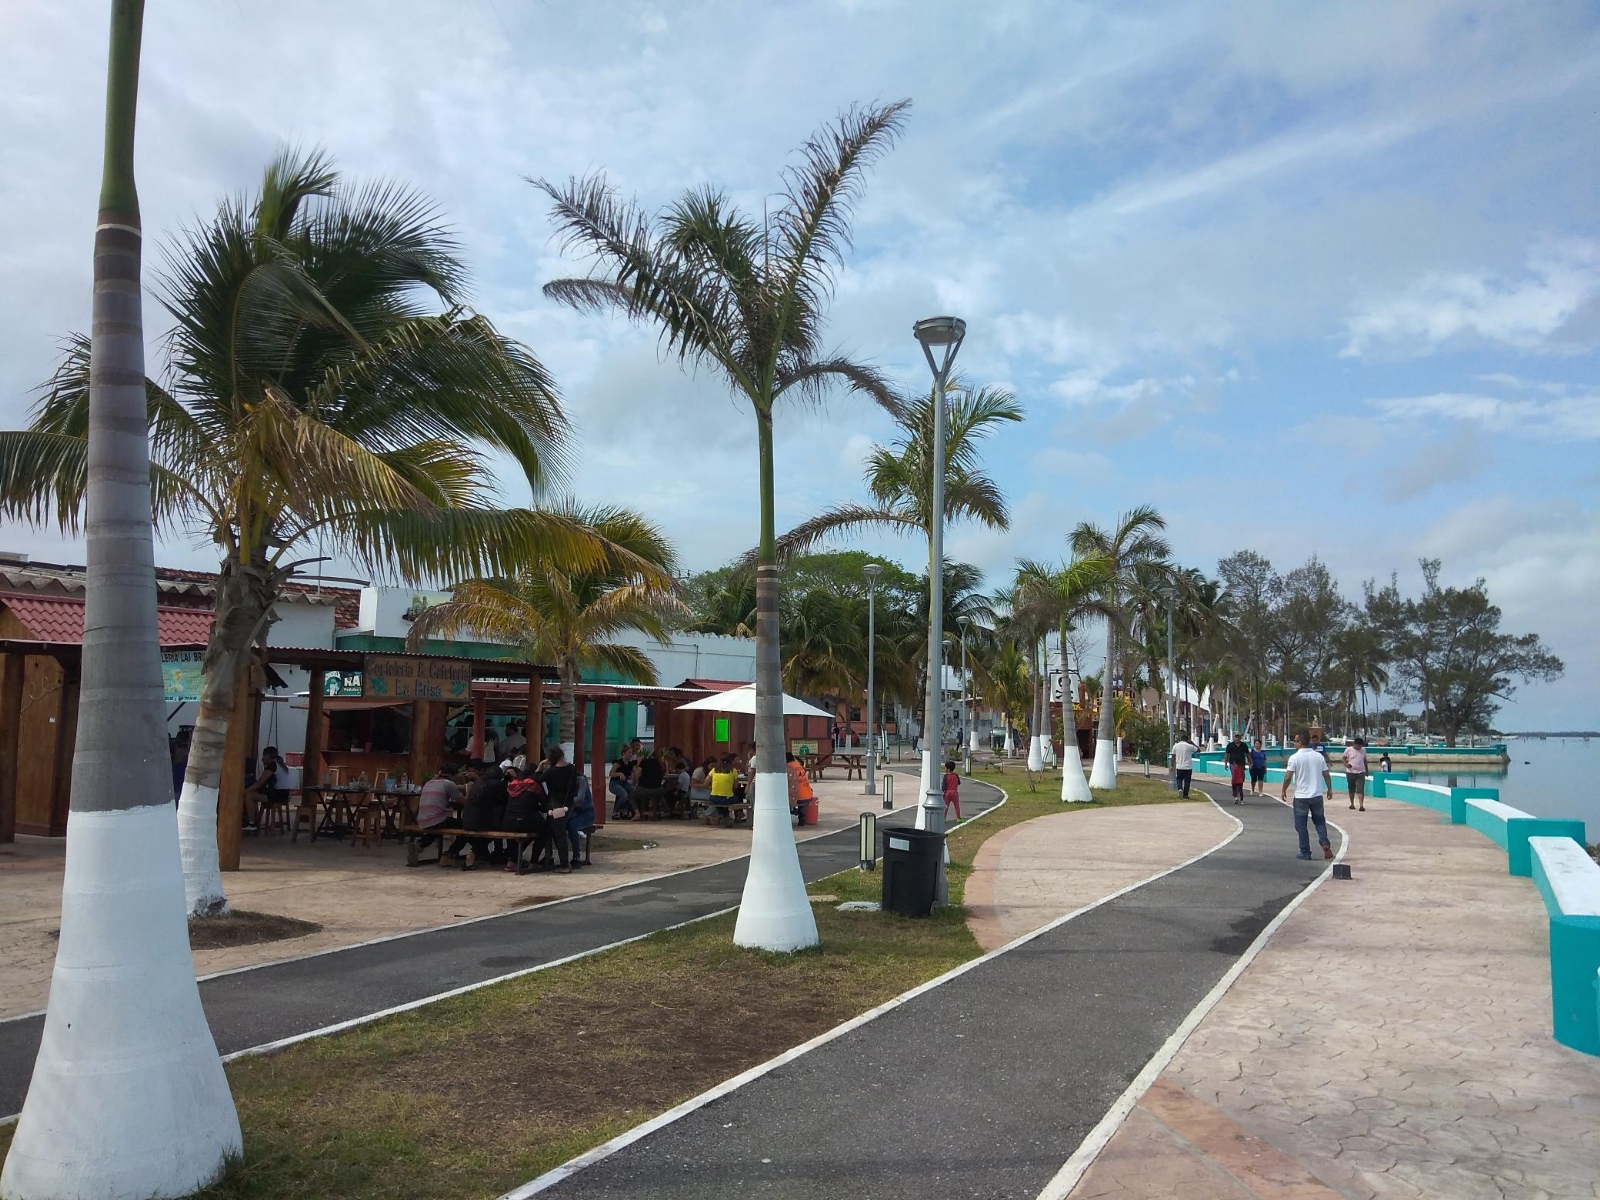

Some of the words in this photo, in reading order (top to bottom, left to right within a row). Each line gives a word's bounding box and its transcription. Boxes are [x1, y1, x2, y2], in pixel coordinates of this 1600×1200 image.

[418, 660, 427, 679] &
[396, 678, 411, 697] La
[415, 680, 443, 698] Brisa
